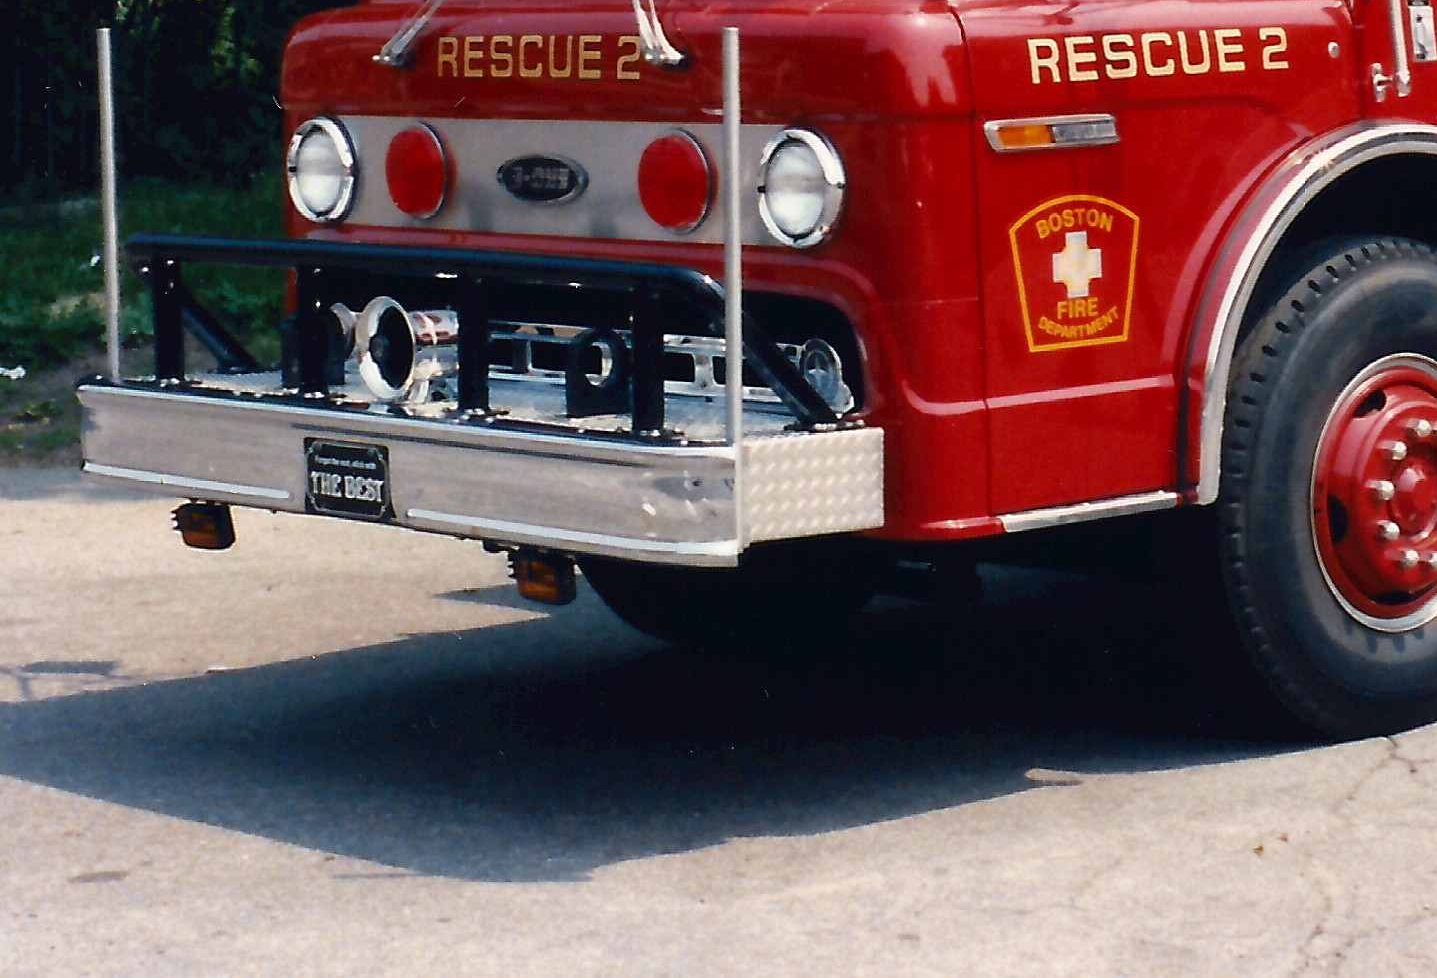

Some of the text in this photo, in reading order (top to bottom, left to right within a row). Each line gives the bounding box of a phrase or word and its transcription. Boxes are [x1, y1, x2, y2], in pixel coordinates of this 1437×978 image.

[437, 35, 642, 80] RESCUE 2
[1027, 26, 1290, 85] RESCUE 2
[1035, 208, 1114, 239] BOSTON
[1038, 305, 1119, 338] DEPARTMENT
[1057, 297, 1099, 320] FIRE
[310, 470, 342, 498] THE
